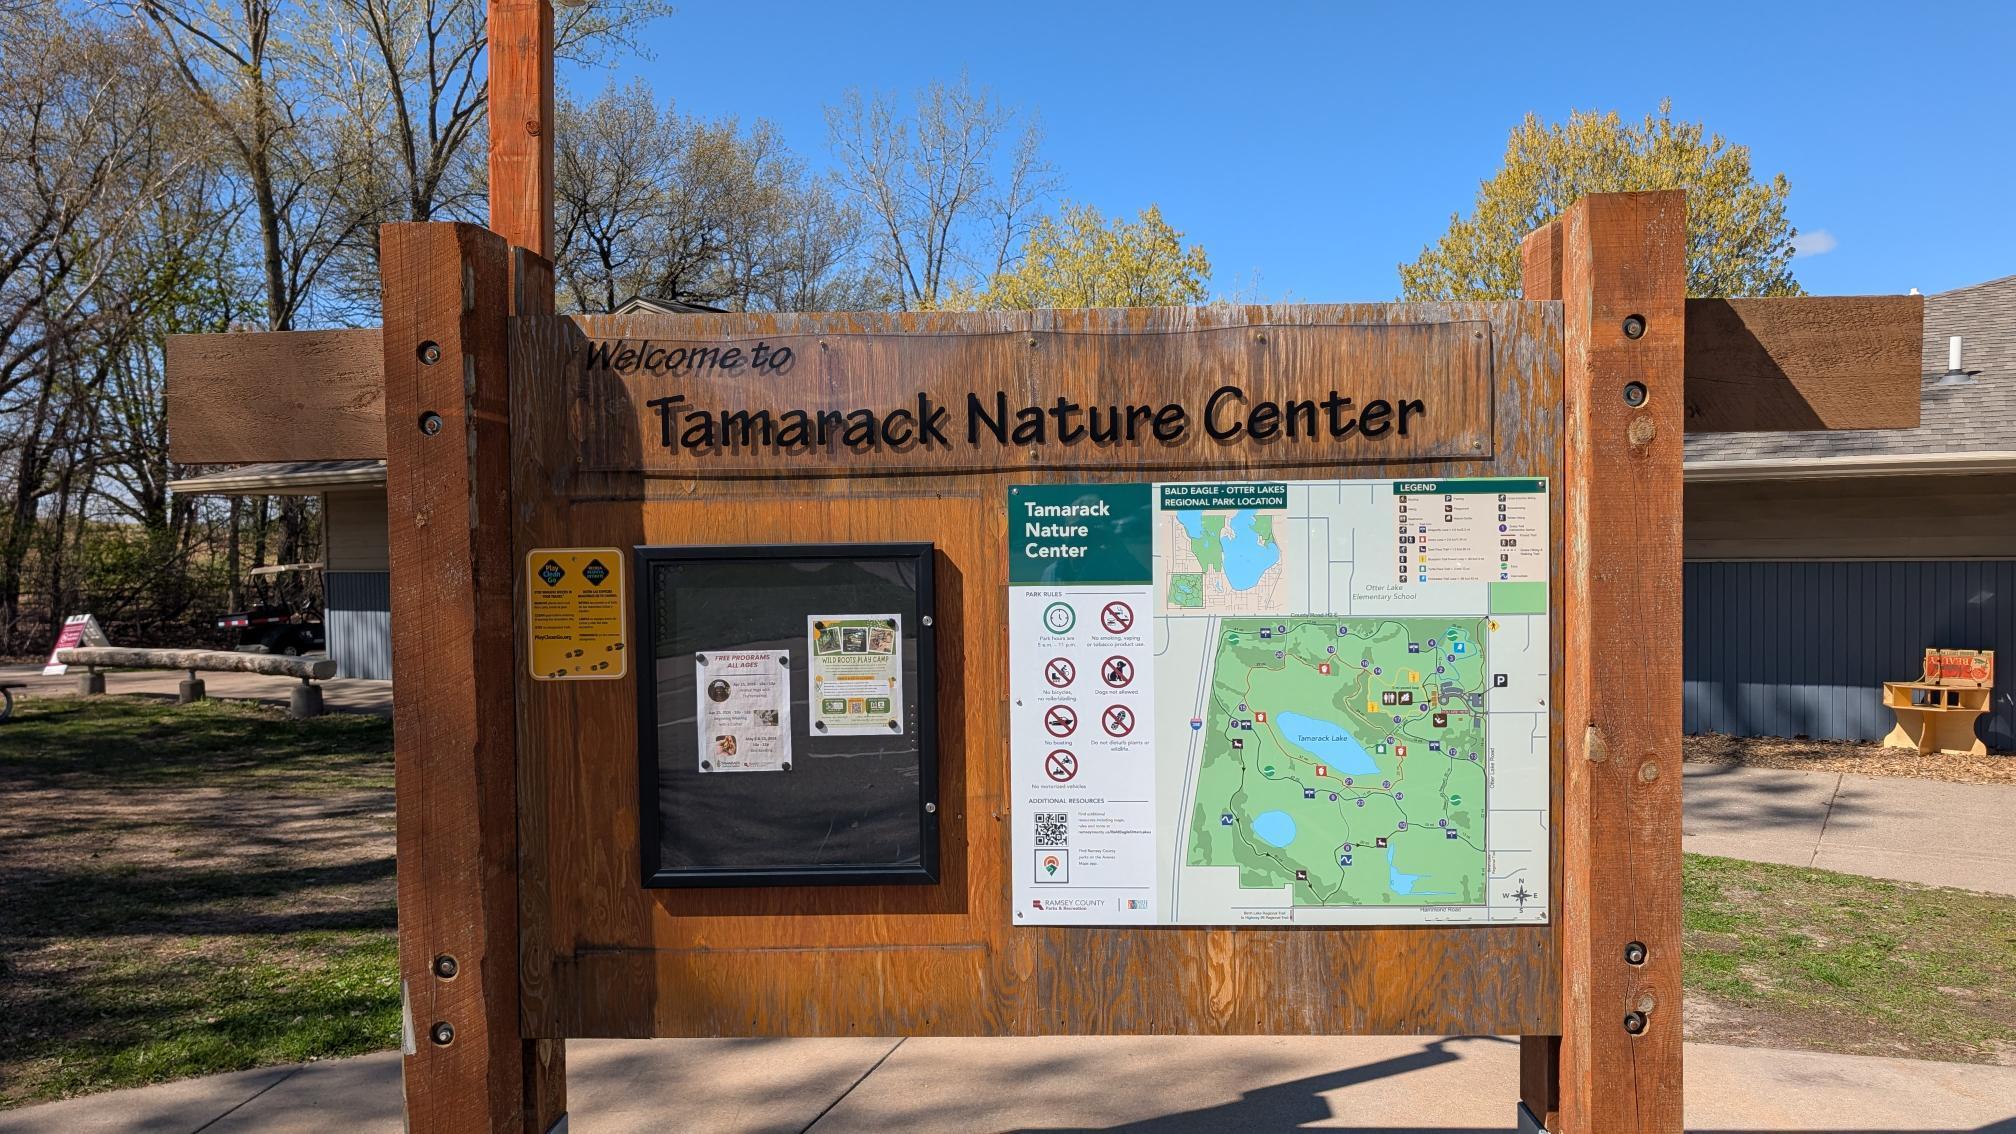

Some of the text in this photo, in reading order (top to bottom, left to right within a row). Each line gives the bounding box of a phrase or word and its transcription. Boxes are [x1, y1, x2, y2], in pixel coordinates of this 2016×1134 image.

[586, 339, 792, 371] Welcome to
[647, 385, 1424, 448] Tamarack Nature Center
[1257, 486, 1285, 494] LAKES
[1400, 483, 1437, 492] LEGEND
[1024, 500, 1110, 516] Tamarack
[1025, 522, 1088, 537] Nature
[1025, 542, 1088, 558] Center
[1928, 657, 1969, 665] BEAUY
